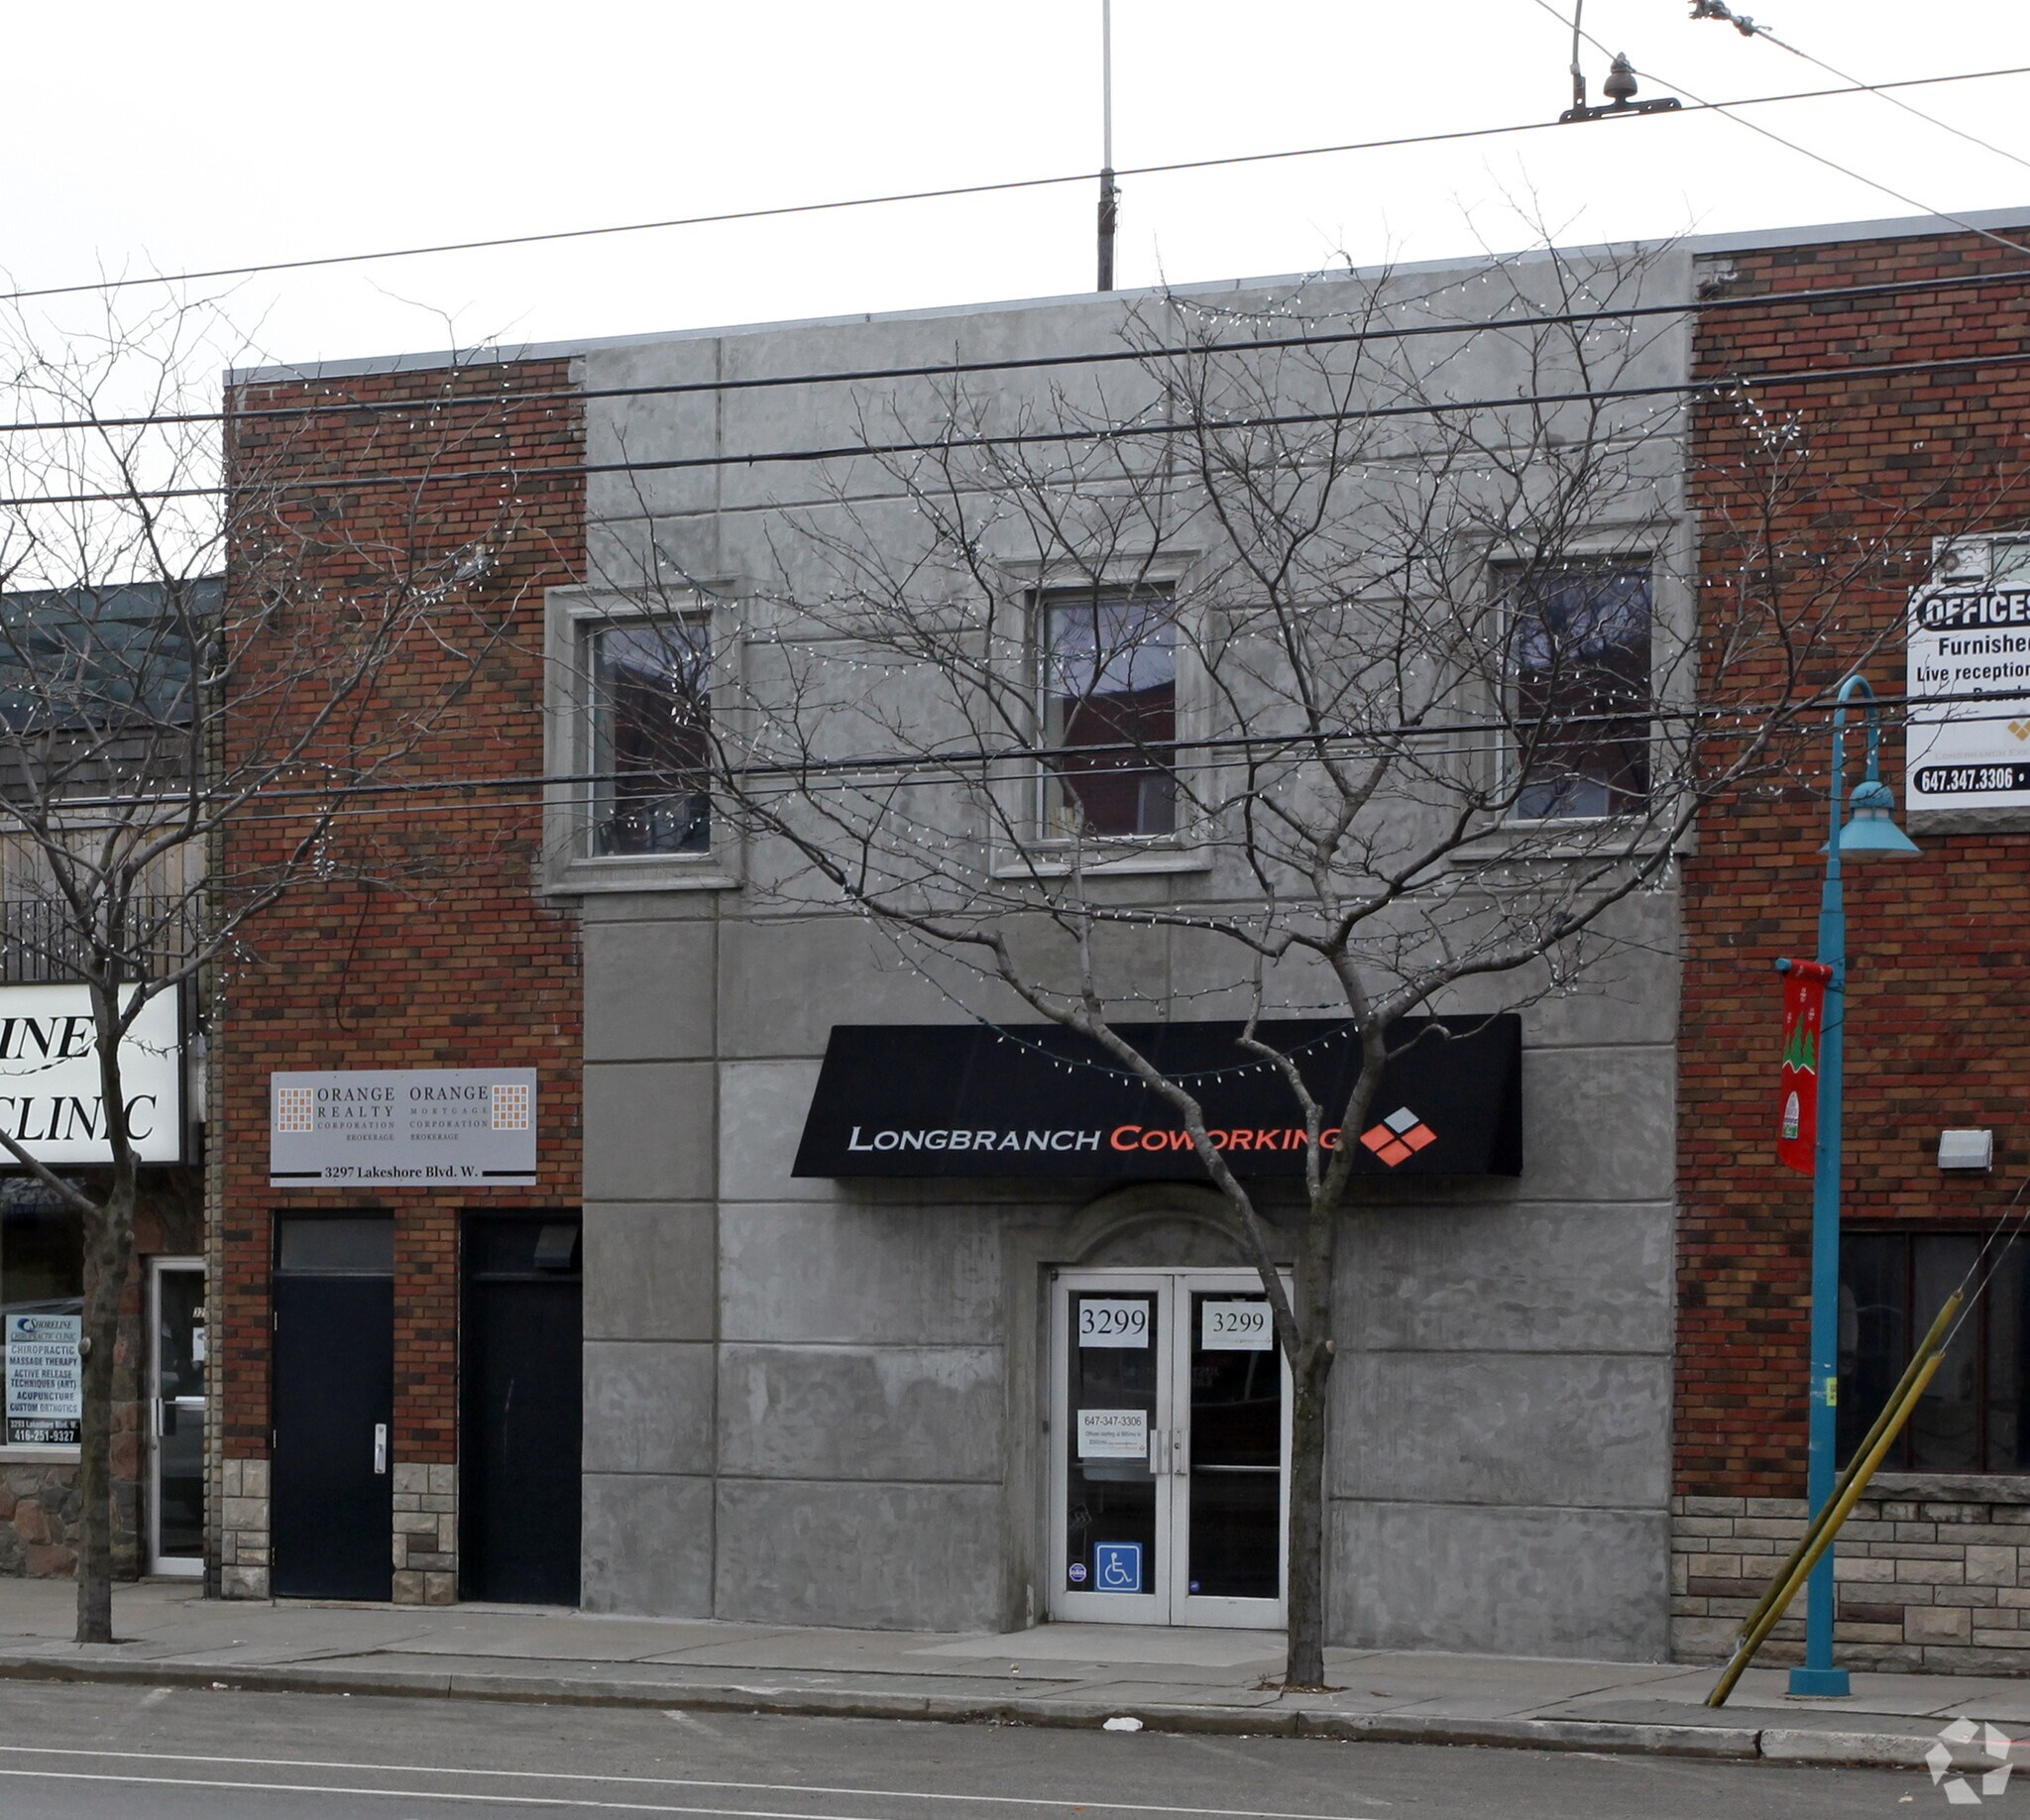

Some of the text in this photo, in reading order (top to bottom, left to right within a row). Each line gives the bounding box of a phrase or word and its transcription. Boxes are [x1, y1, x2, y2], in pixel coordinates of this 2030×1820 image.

[1939, 633, 2030, 656] Furnishe
[1917, 665, 1950, 682] Live
[1921, 767, 2014, 792] 647.347.3306
[317, 1086, 395, 1102] ORANGE
[409, 1085, 489, 1101] ORANGE
[317, 1105, 395, 1118] REALTY
[847, 1126, 1102, 1151] LONGBRANCH
[324, 1165, 478, 1178] 3297 Lakeshore Blvd. W.
[1081, 1308, 1146, 1335] 3299
[1213, 1312, 1264, 1332] 3299
[11, 1345, 75, 1355] CHIROPRACTIC
[9, 1357, 78, 1367] MASSAGE THERAPY
[14, 1369, 72, 1379] ACTIVE RELEASE
[11, 1379, 56, 1388] TECHNIQUES
[17, 1391, 75, 1401] ACUPUNCTURE
[10, 1403, 78, 1413] CUSTOM ORTHOTICS
[1084, 1416, 1142, 1426] 647-347-3306
[15, 1429, 74, 1441] 416-251-9327
